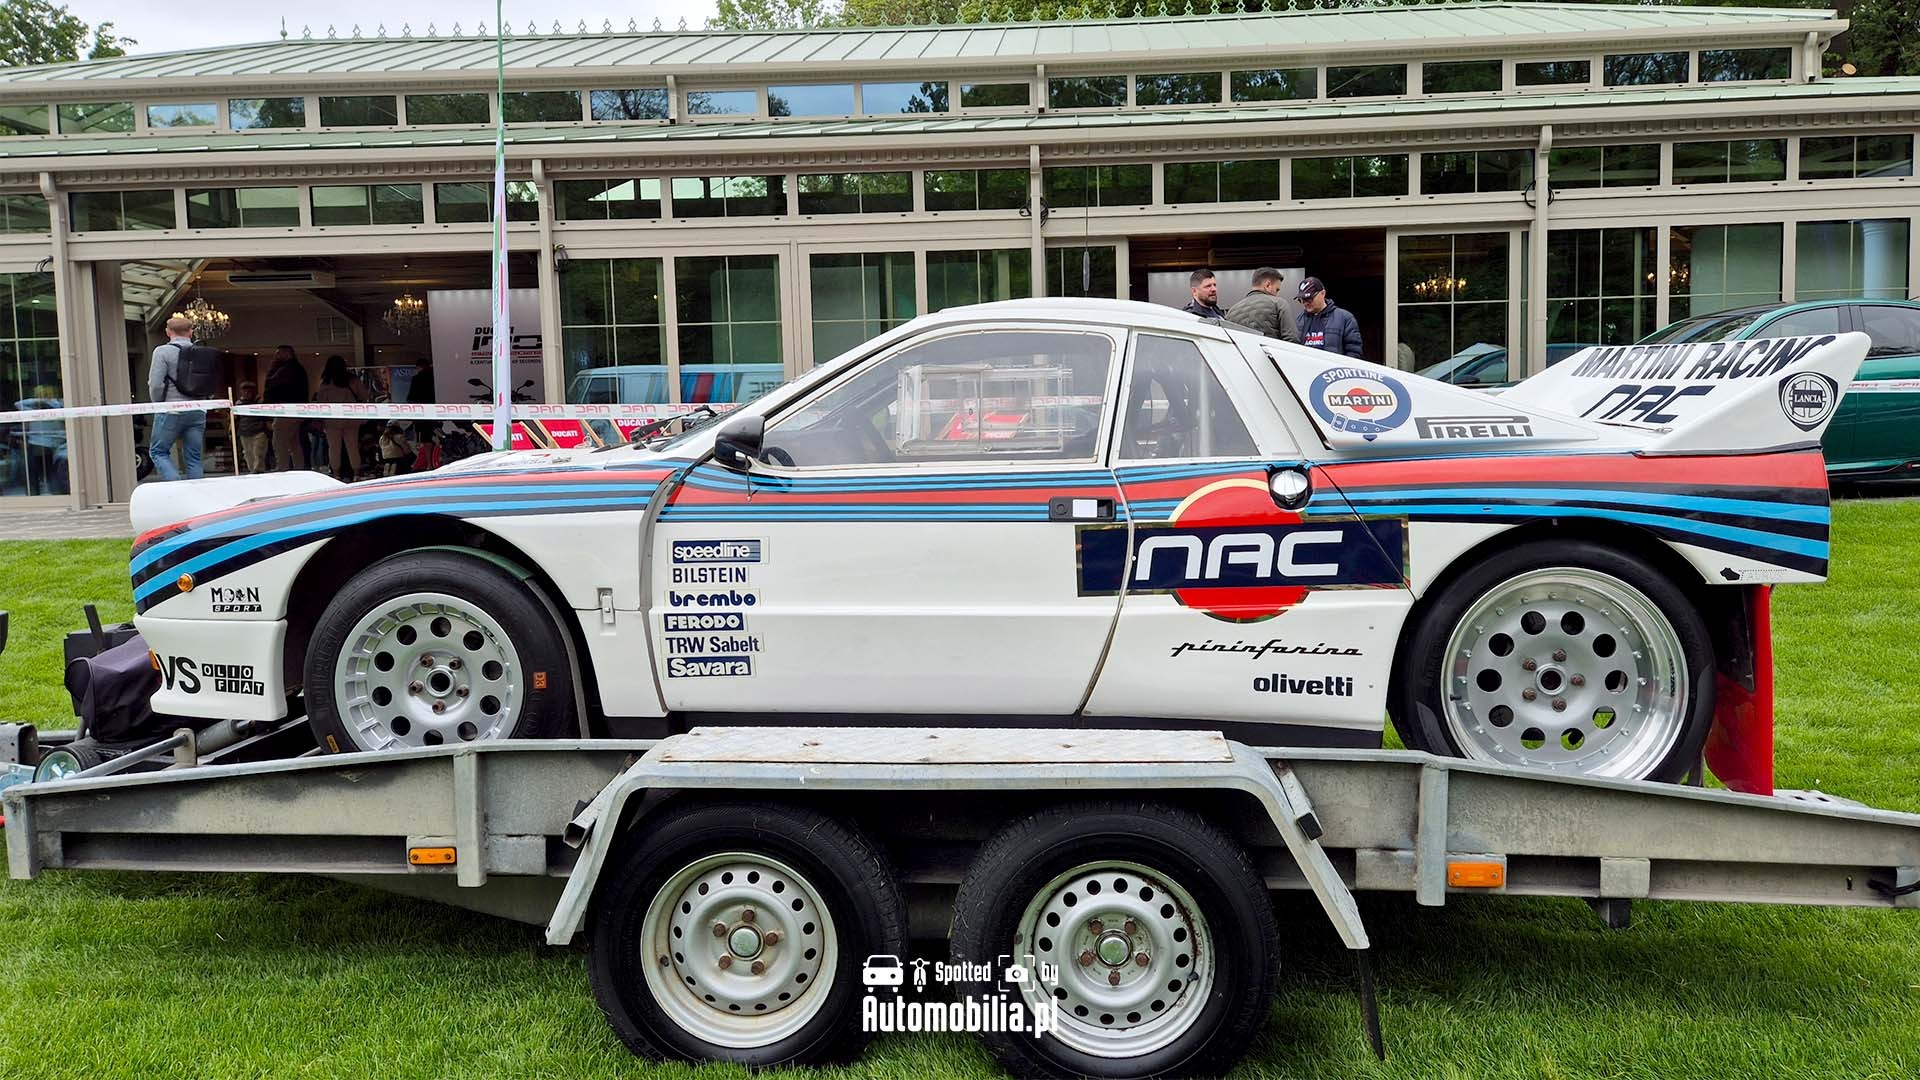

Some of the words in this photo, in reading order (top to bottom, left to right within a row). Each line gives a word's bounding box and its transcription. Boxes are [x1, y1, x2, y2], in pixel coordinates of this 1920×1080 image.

[1571, 344, 1697, 379] MARTINI
[1322, 366, 1384, 383] SPORTLINE
[1329, 395, 1392, 406] MARTINI
[1579, 384, 1716, 423] NAC
[1794, 394, 1822, 403] LANCIA
[618, 419, 648, 427] DUCATI
[1414, 416, 1533, 439] PIRELLI
[673, 542, 750, 561] speedline
[1135, 530, 1343, 581] NAC
[673, 567, 746, 583] BILSTEIN
[669, 590, 756, 606] brembo
[214, 604, 261, 612] SPORT
[667, 615, 740, 629] FERODO
[665, 637, 705, 653] TRW
[709, 635, 760, 652] Sabelt
[1171, 639, 1362, 659] pininfarina
[203, 664, 253, 679] OLIO
[670, 658, 749, 677] Savara
[216, 679, 264, 695] FIAT
[1254, 673, 1353, 697] olivetti
